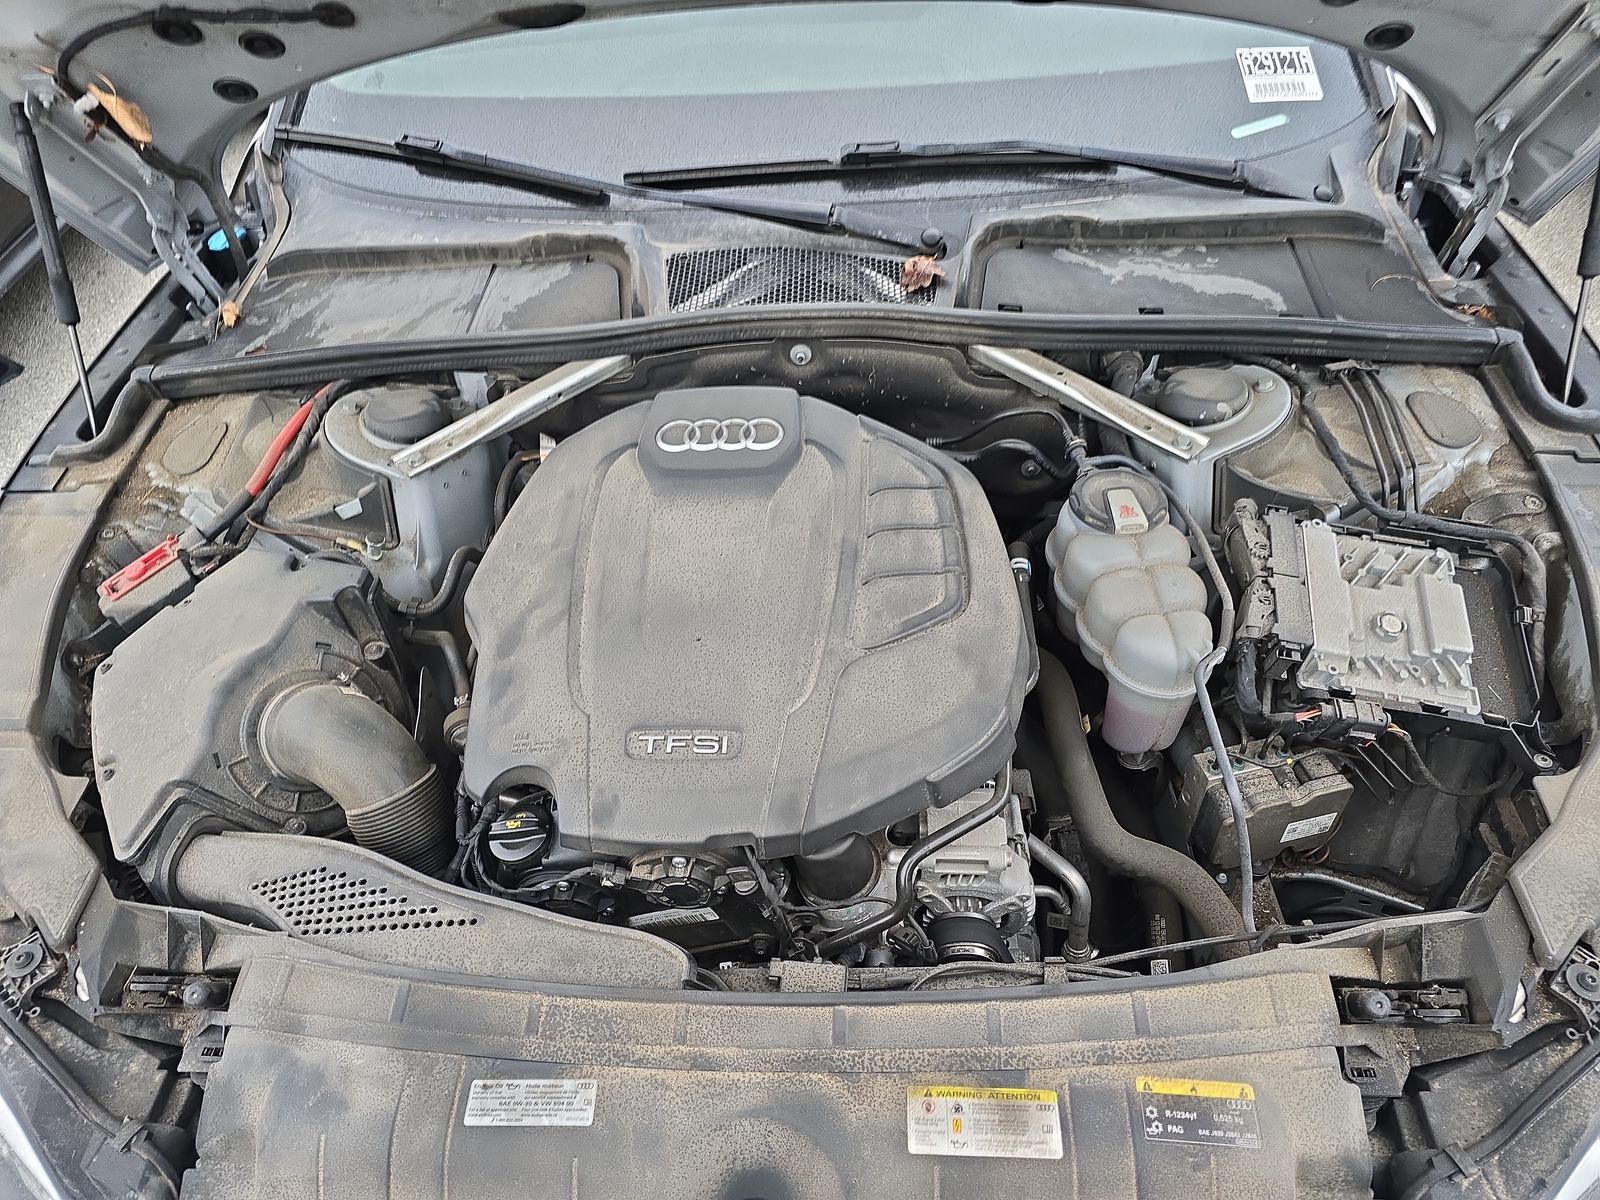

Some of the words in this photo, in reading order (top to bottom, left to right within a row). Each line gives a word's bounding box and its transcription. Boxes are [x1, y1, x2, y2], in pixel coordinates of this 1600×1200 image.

[1240, 51, 1313, 75] A29121A
[638, 735, 728, 754] TFSI
[936, 1090, 983, 1099] WARNING
[988, 1091, 1041, 1101] ATTENTION
[1165, 1109, 1198, 1120] R-1234yf
[1167, 1124, 1185, 1134] PAG
[1198, 1128, 1210, 1136] SAE
